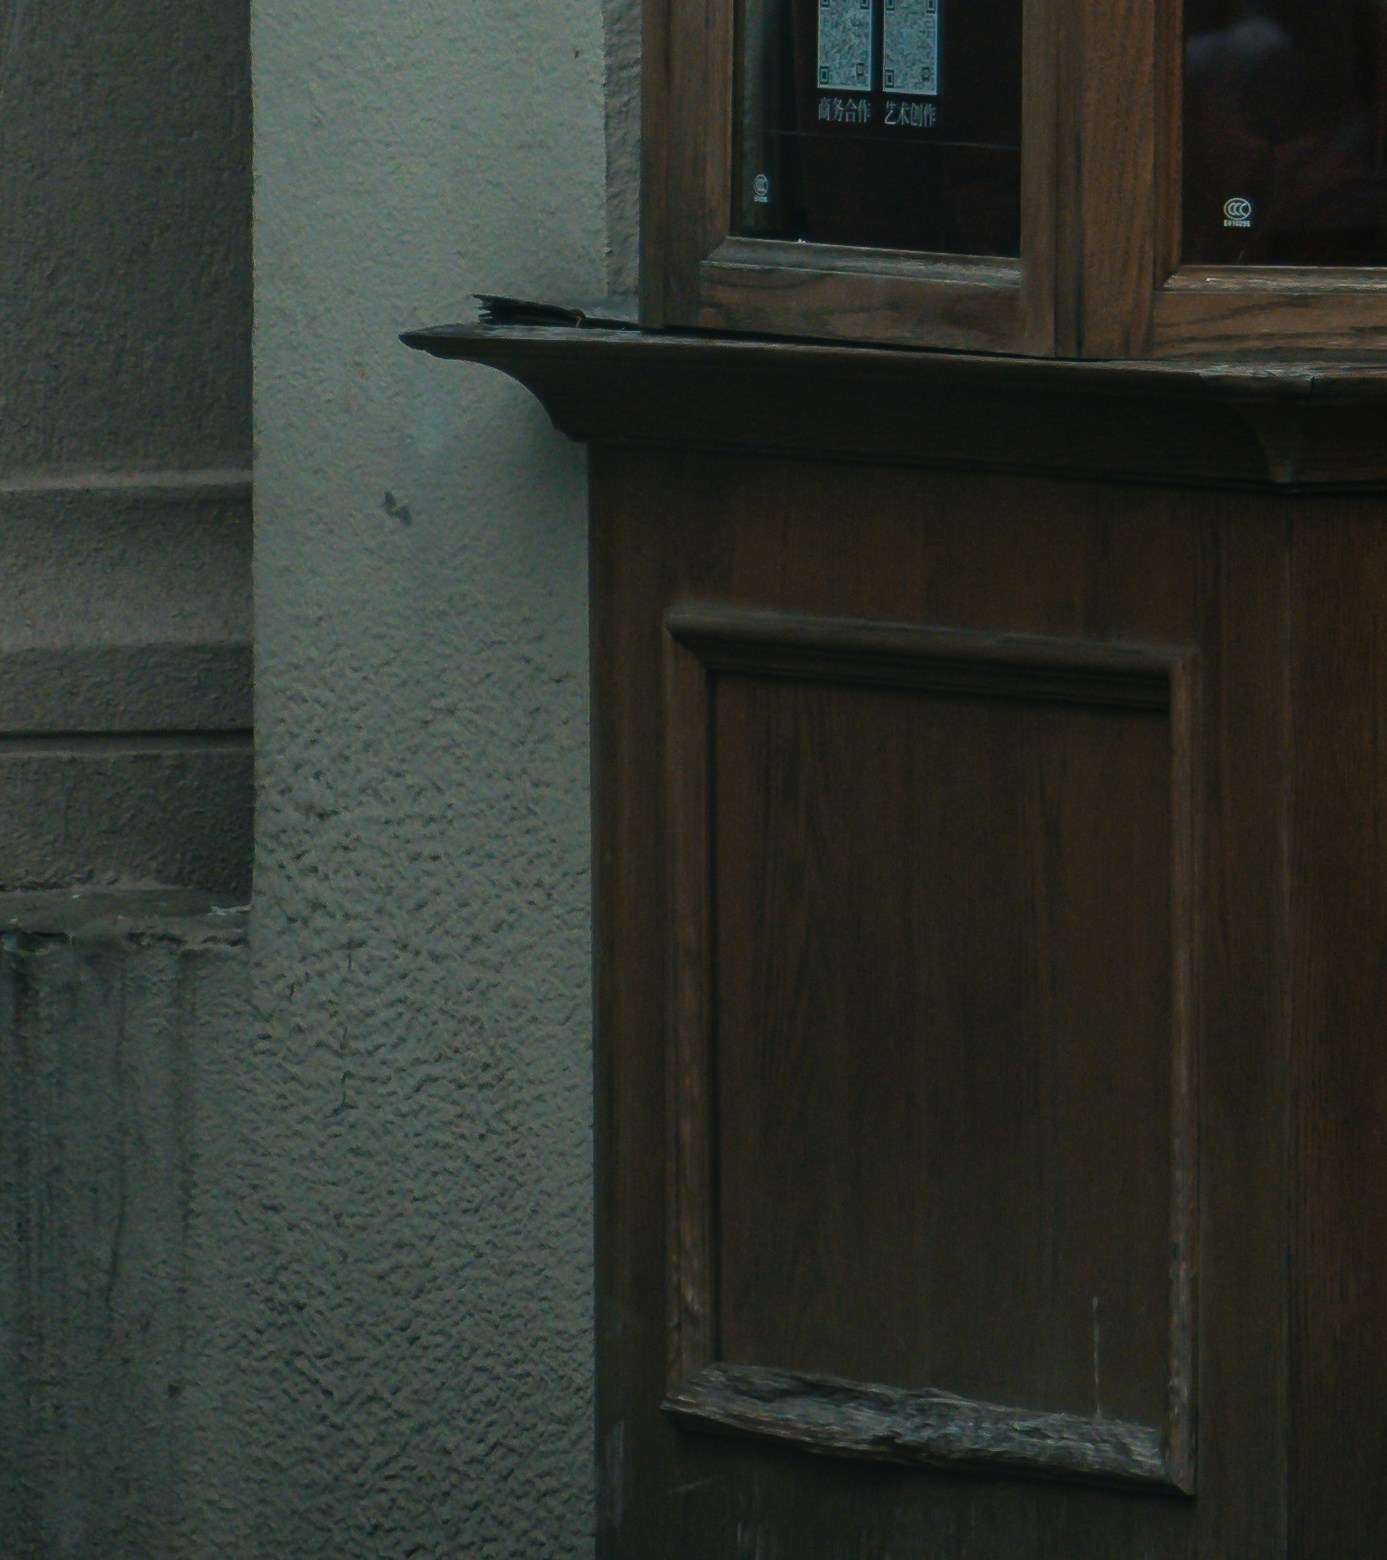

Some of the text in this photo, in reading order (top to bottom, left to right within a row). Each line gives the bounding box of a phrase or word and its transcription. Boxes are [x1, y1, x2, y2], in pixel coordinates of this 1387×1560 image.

[818, 95, 938, 127] 商务合作 艺术创作
